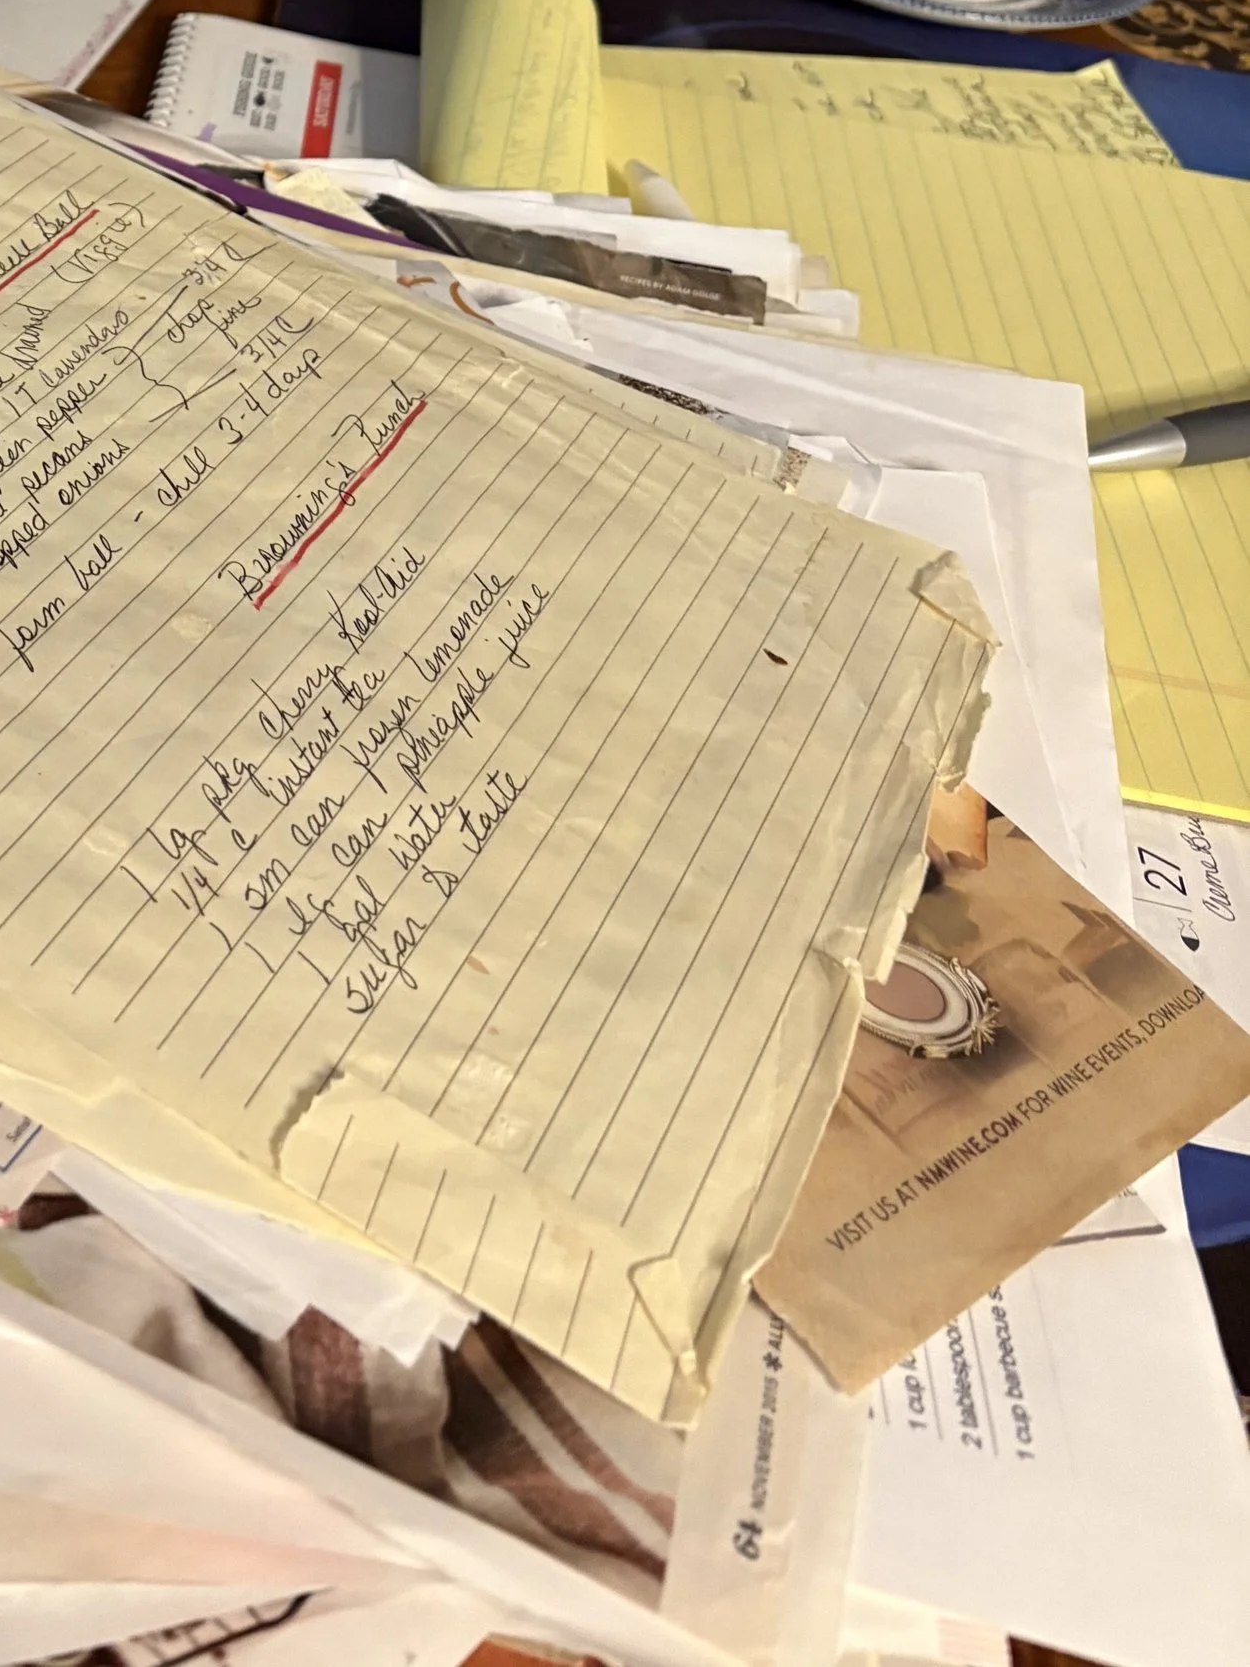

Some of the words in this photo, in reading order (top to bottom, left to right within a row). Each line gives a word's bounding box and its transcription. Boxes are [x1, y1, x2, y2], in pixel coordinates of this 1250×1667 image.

[34, 188, 97, 242] Ball
[620, 274, 652, 289] RECIPES
[653, 282, 664, 291] BY
[165, 298, 215, 345] chop
[36, 372, 108, 440] pepper
[20, 430, 94, 504] pecans
[57, 438, 132, 507] onions
[64, 533, 123, 593] ball
[156, 445, 217, 508] chill
[261, 346, 323, 400] days
[217, 459, 360, 602] Browning's
[330, 379, 427, 458] Punch
[120, 865, 158, 903] 1
[200, 753, 271, 823] pkg
[250, 663, 347, 741] cherry
[326, 544, 427, 655] Kool-Aid
[290, 793, 347, 848] can
[339, 694, 422, 795] frozen
[404, 570, 516, 684] lemonade
[331, 812, 390, 868] can
[497, 582, 551, 670] juice
[170, 866, 221, 917] 1/4
[266, 706, 342, 808] instant
[341, 668, 386, 711] tea
[341, 877, 386, 944] gal
[389, 794, 459, 870] water
[345, 914, 427, 1015] sugar
[421, 864, 460, 899] to
[459, 768, 529, 856] taste
[1136, 845, 1189, 898] 27
[825, 1211, 874, 1253] VISIT
[869, 1194, 900, 1225] US
[894, 1180, 920, 1209] AT
[913, 1109, 1023, 1194] NMWINE.COM
[1018, 1088, 1056, 1124] FOR
[1048, 1061, 1094, 1100] WINE
[1085, 1026, 1147, 1075] EVENTS,
[990, 1303, 1025, 1401] barbecue
[904, 1374, 928, 1416] cup
[907, 1419, 929, 1432] 1
[1010, 1403, 1034, 1446] cup
[961, 1432, 983, 1451] 2
[1016, 1448, 1036, 1462] 1
[732, 1519, 764, 1562] 64
[751, 1413, 774, 1512] NOVEMBER
